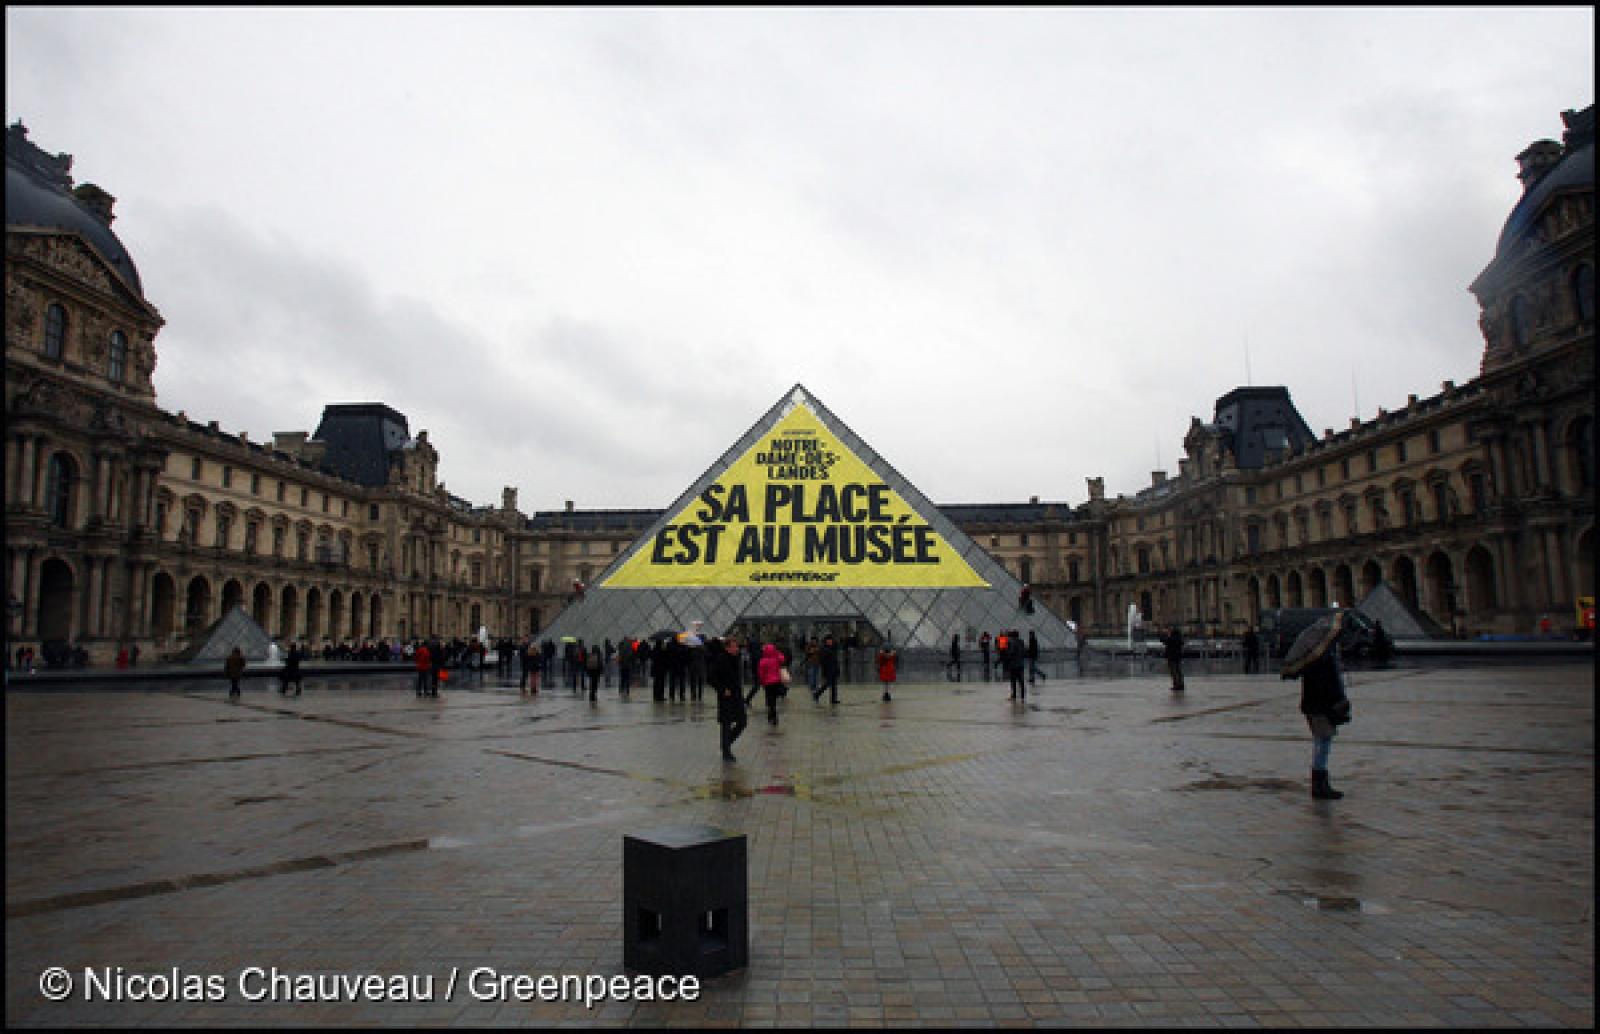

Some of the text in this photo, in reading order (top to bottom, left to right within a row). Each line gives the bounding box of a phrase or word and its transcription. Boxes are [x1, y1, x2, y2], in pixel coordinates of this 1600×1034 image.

[697, 484, 894, 523] SA PLACE
[650, 514, 941, 565] EST AU MUSÉE
